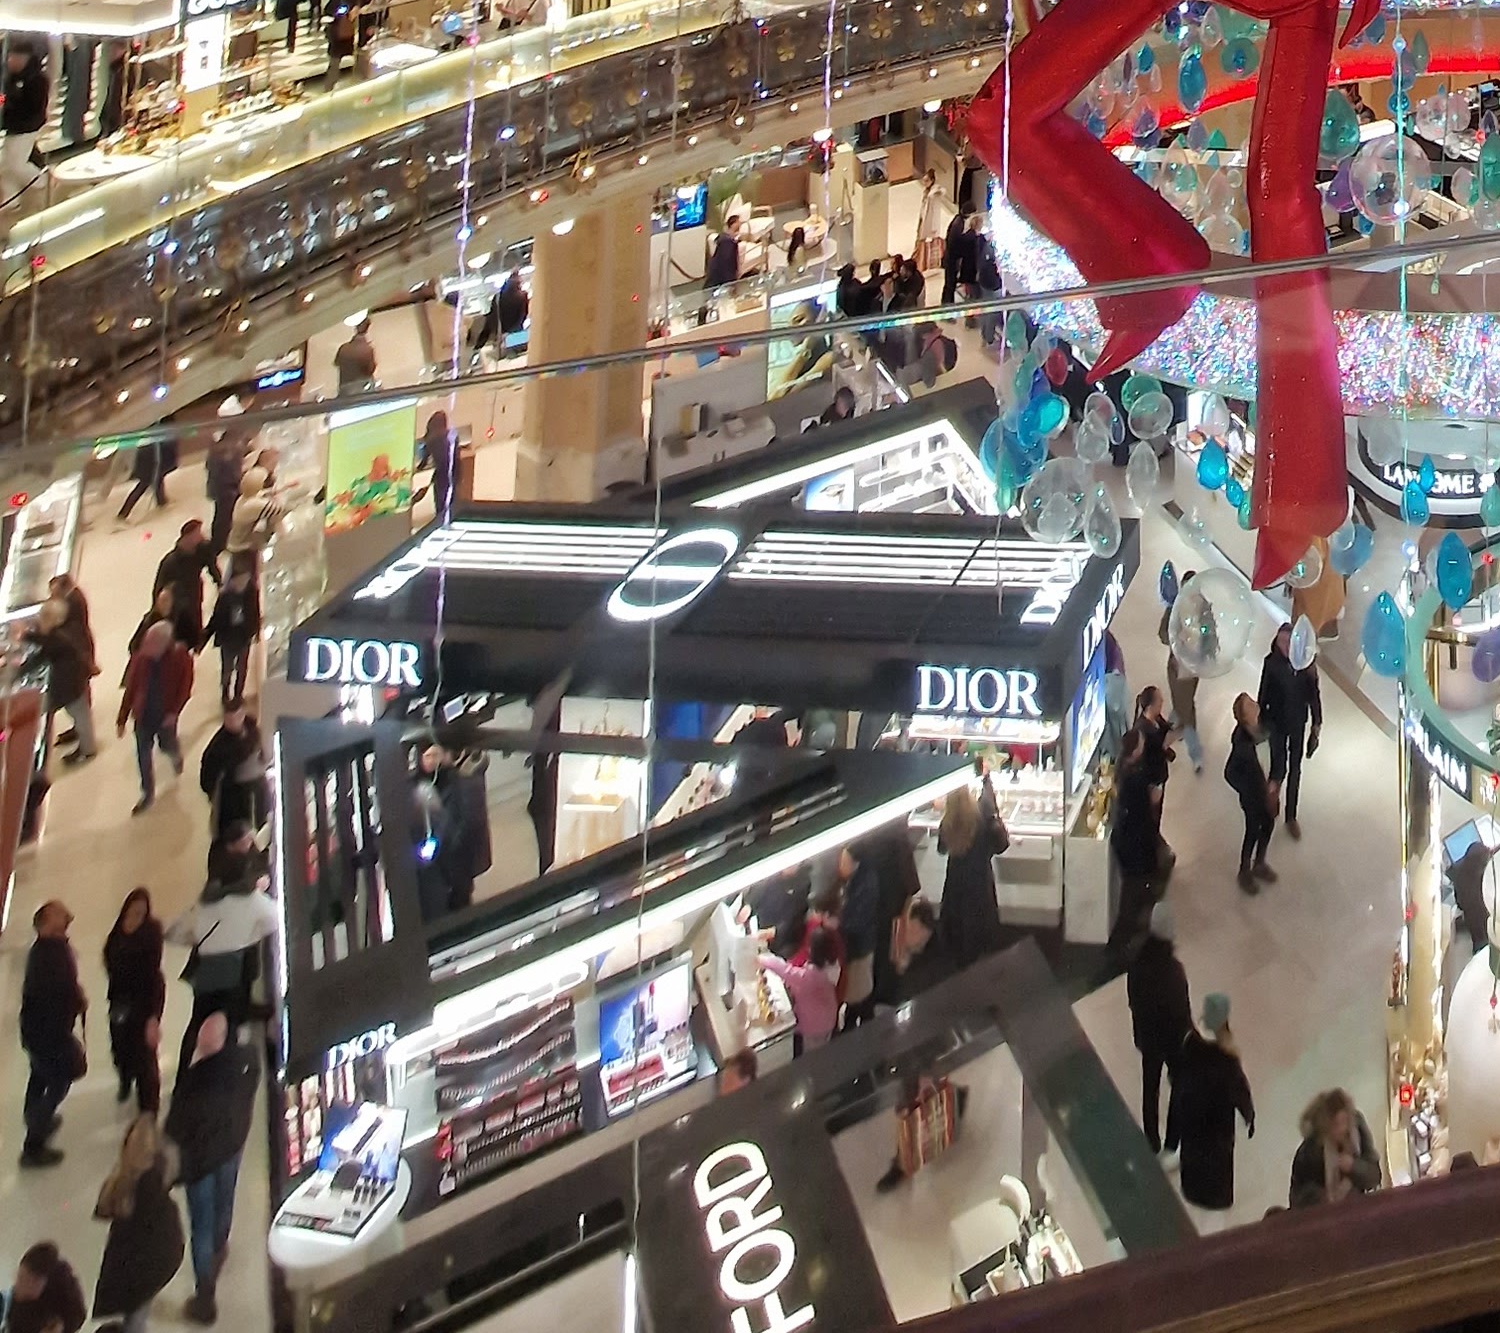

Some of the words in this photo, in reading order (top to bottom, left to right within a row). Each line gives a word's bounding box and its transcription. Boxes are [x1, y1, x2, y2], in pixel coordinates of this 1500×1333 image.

[1082, 563, 1124, 671] DIOR
[303, 637, 423, 686] DIOR
[916, 665, 1043, 715] DIOR
[328, 1022, 397, 1070] DIOR
[693, 1142, 817, 1333] FORD
